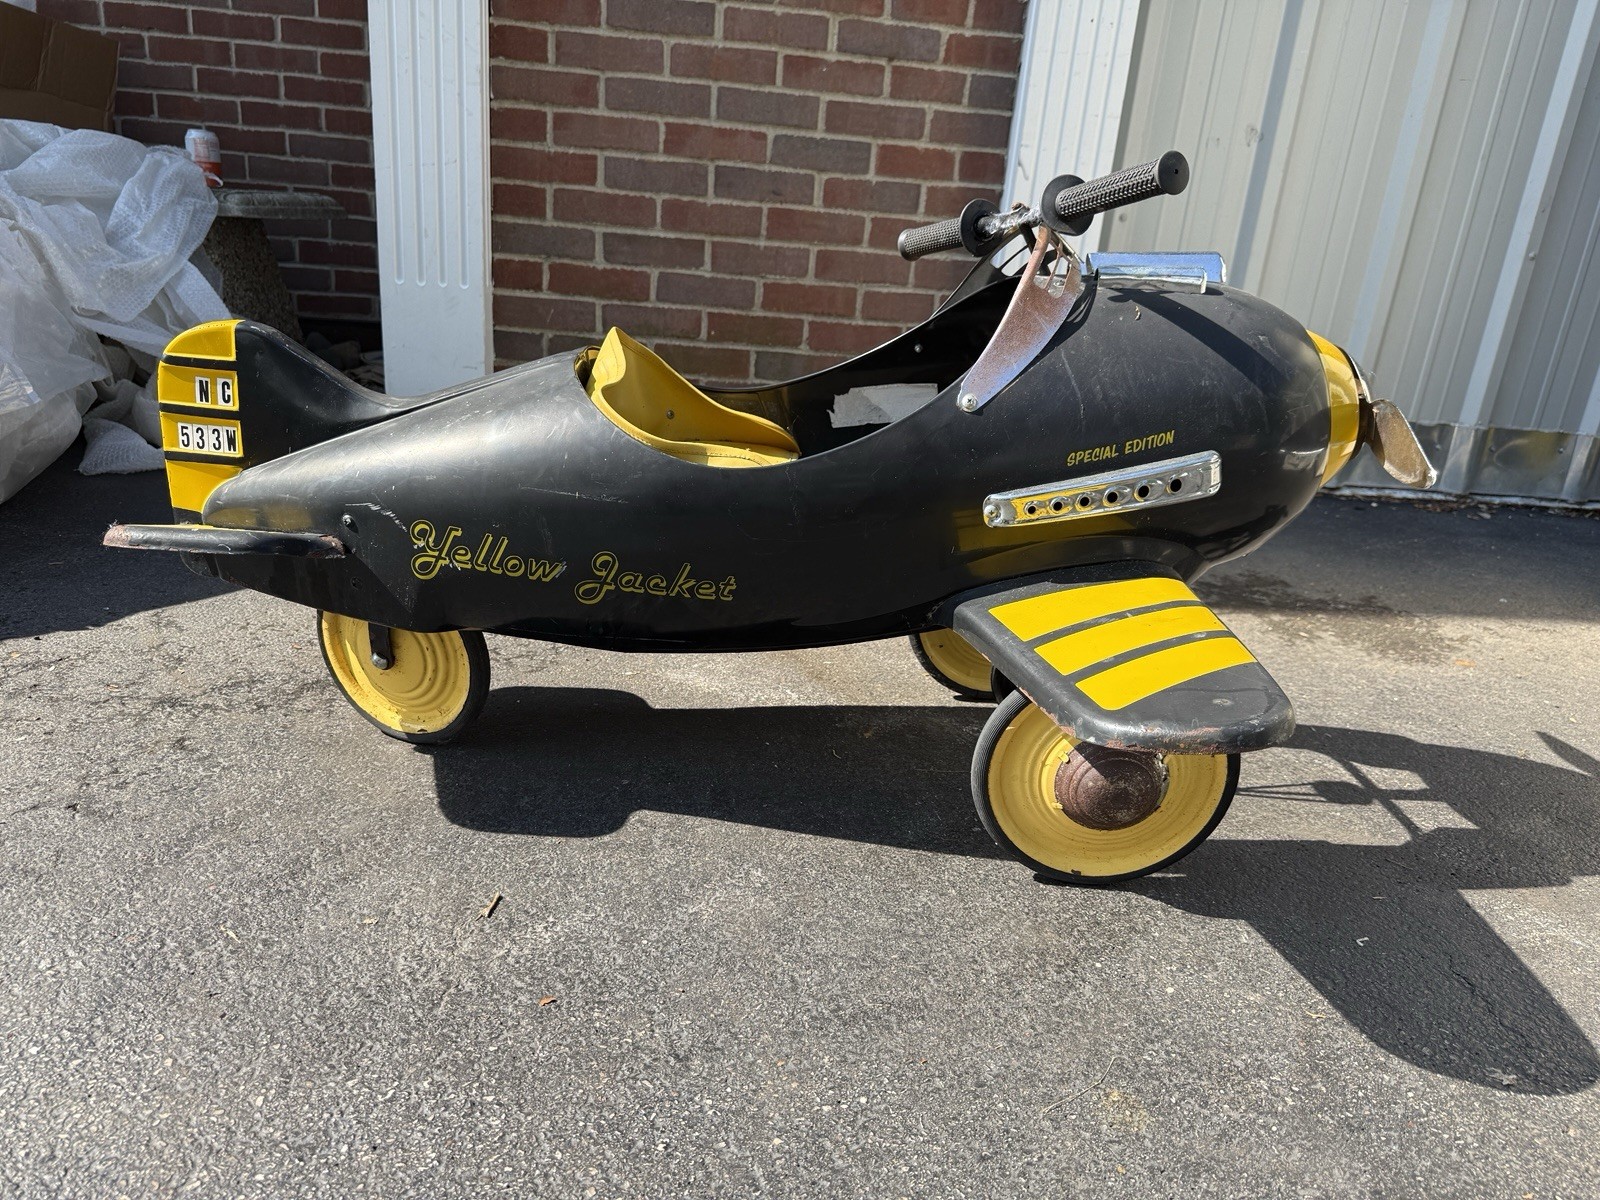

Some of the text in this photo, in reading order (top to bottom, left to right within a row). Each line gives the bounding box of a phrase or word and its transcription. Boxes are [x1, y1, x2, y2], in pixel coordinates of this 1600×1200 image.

[181, 426, 237, 452] 533W
[1067, 429, 1175, 467] SPECIAL EDITION
[410, 519, 737, 604] Yellow Jacket
